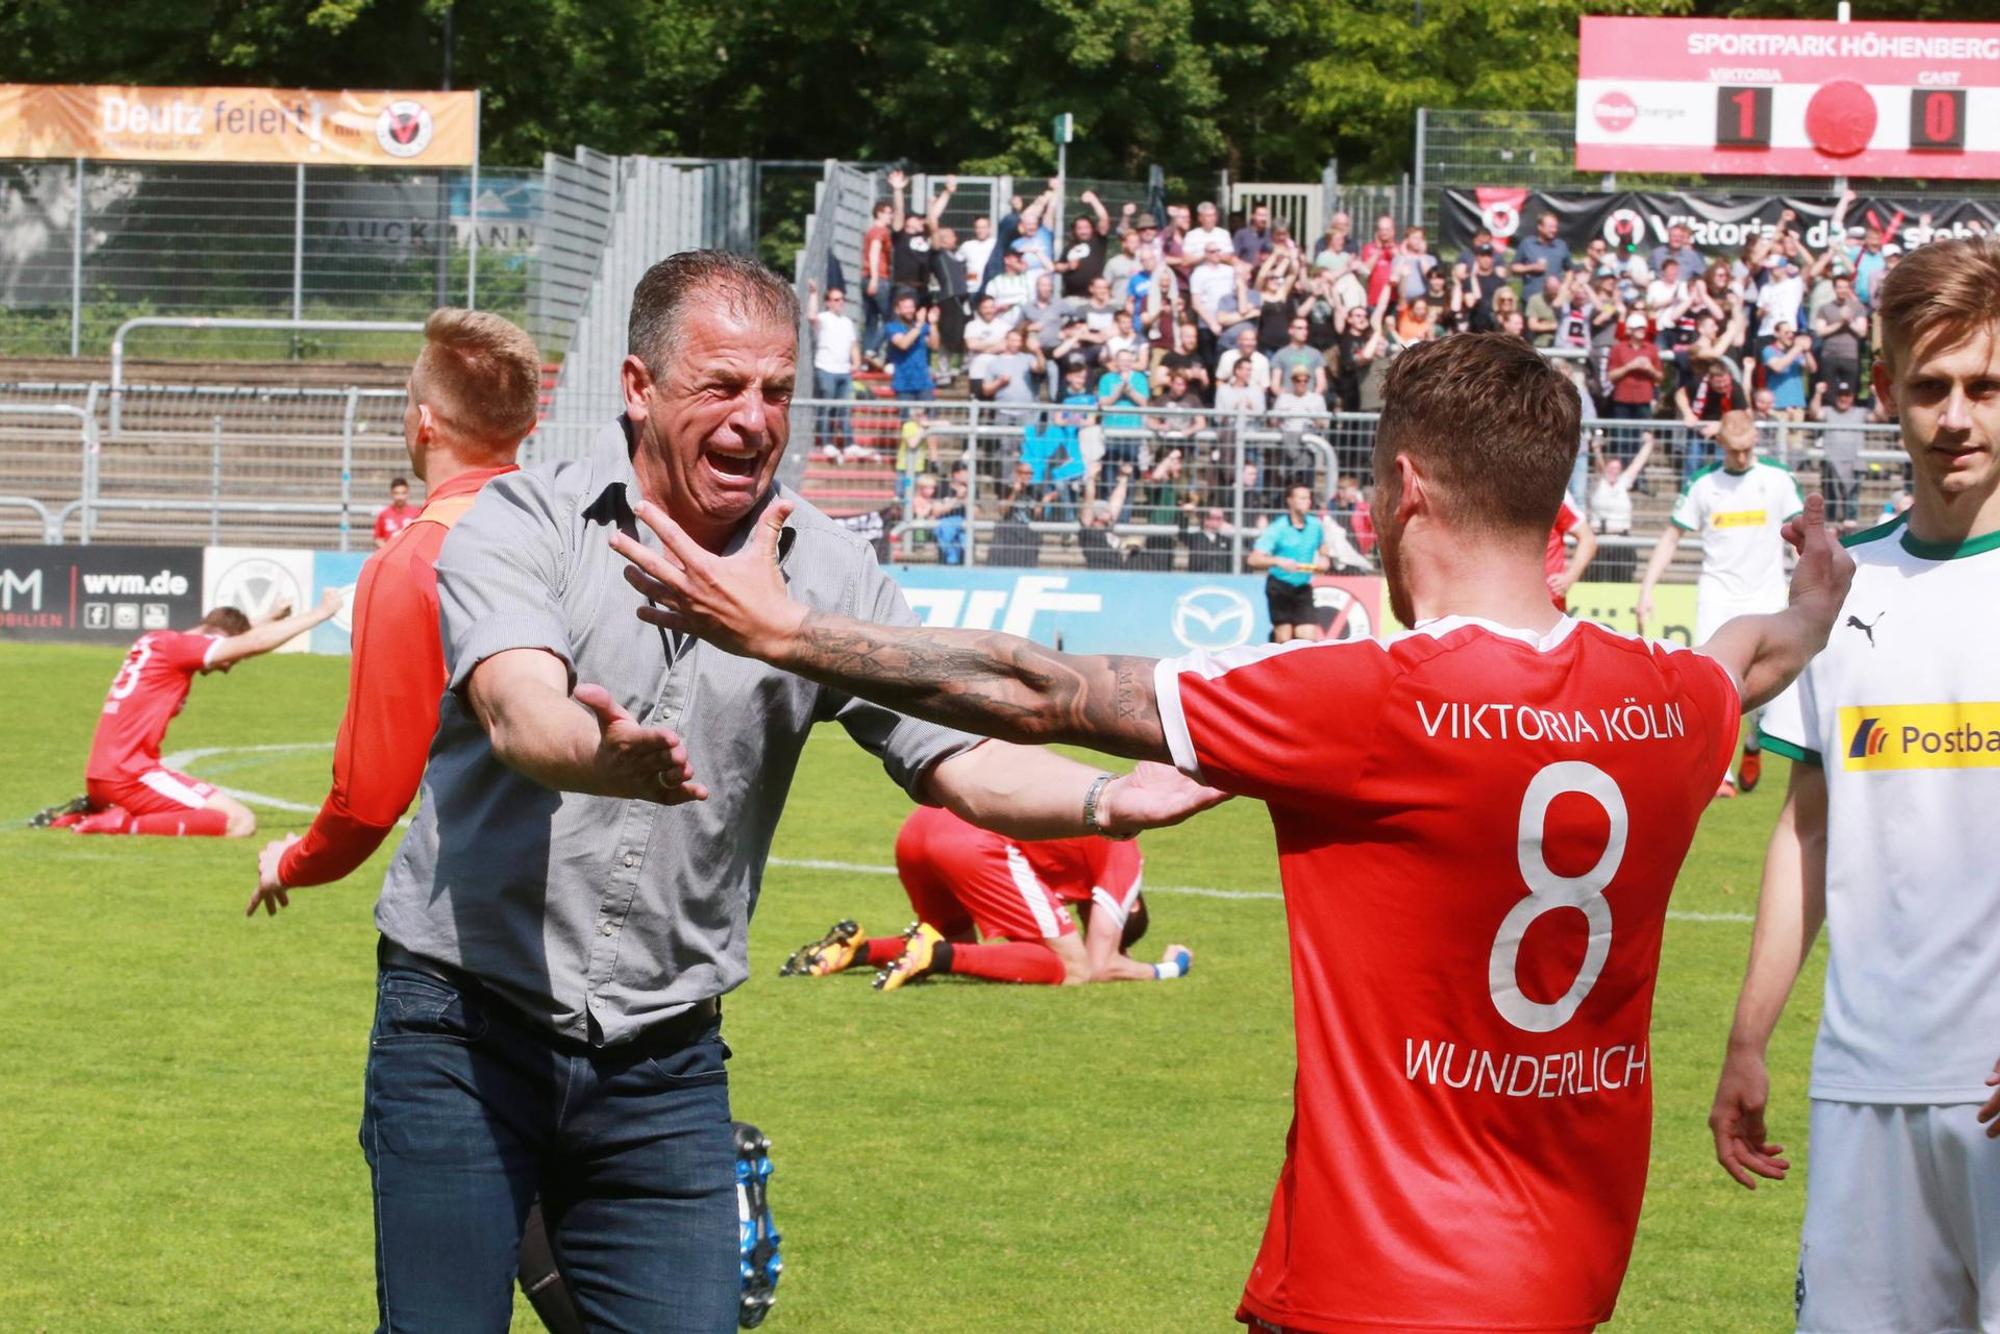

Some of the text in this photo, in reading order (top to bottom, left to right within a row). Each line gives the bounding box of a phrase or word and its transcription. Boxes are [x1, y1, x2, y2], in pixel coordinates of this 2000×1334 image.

[1687, 32, 2000, 60] SPORTPARK HÖHENBERG
[1709, 67, 1783, 82] VIKTORIA
[1918, 71, 1961, 85] GAST
[104, 97, 204, 135] Deutz
[1730, 90, 1757, 139] 1
[1925, 91, 1955, 142] 0
[1650, 214, 1777, 246] Vktoria
[0, 568, 43, 611] M
[83, 569, 189, 596] wvm.de
[1416, 696, 1685, 743] VIKTORIA KÖLN
[1902, 722, 2000, 754] Postba
[1488, 760, 1629, 1033] 8
[1406, 1038, 1647, 1099] WUNDERLICH
